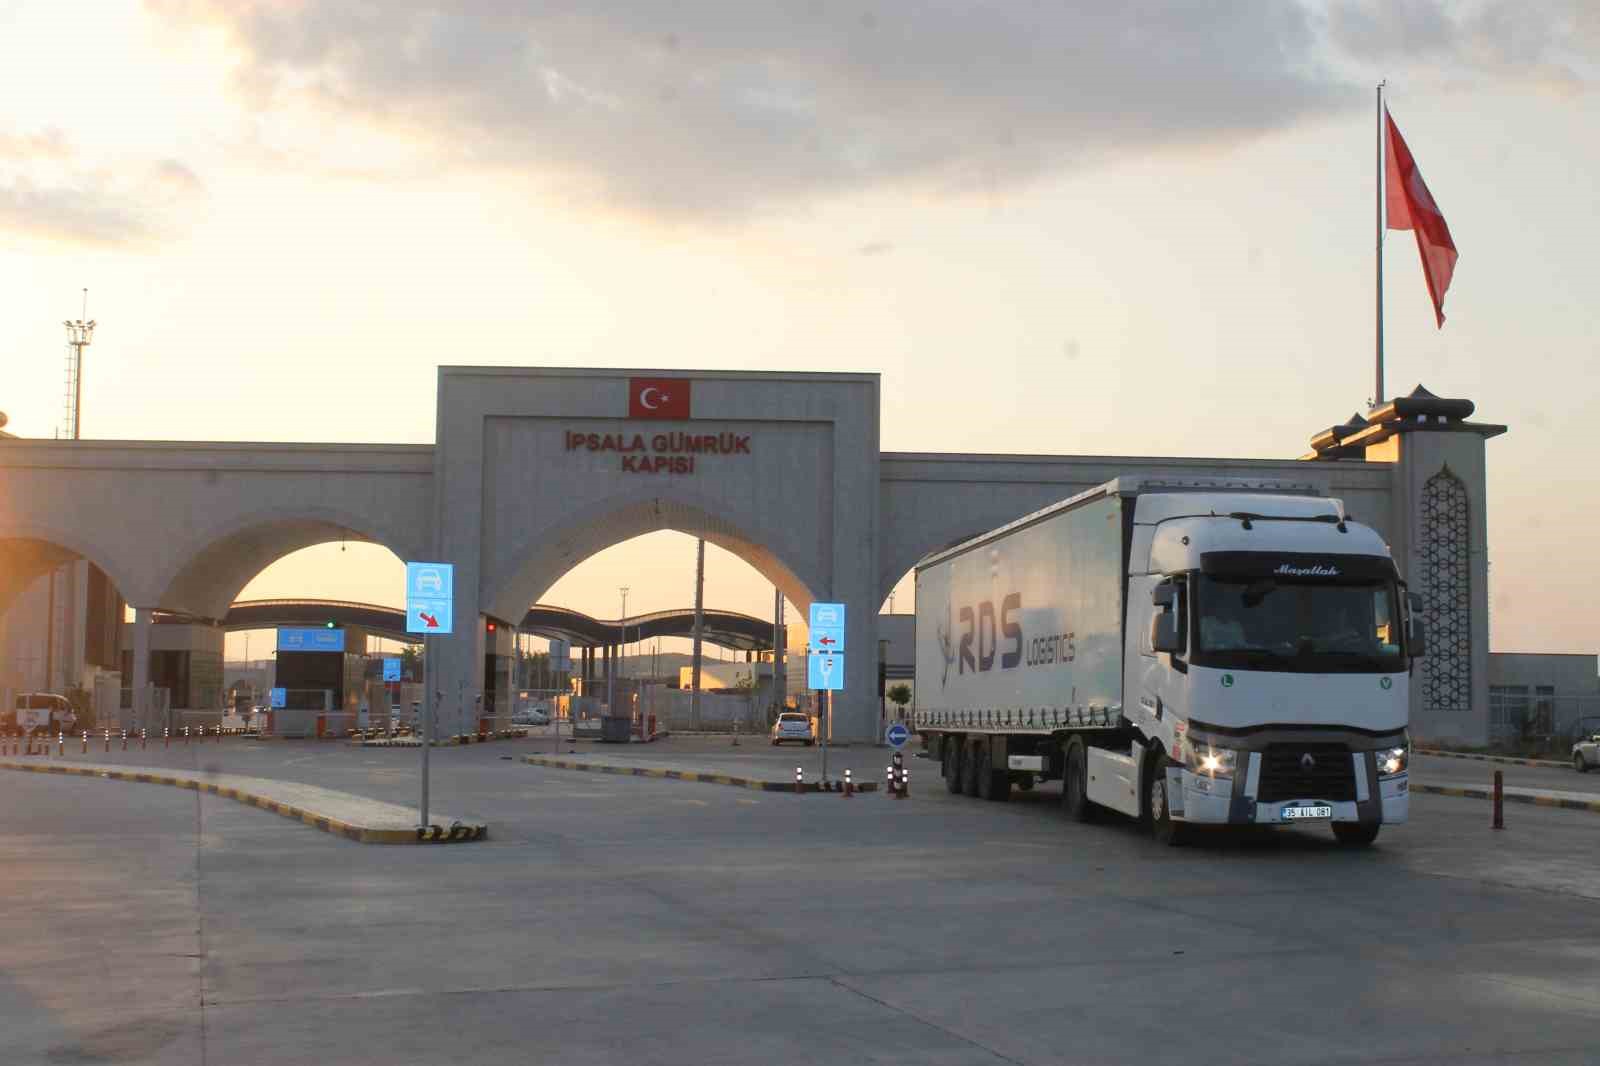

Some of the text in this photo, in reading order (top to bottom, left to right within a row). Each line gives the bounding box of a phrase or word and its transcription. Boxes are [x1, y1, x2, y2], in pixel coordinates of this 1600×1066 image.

[652, 431, 750, 454] GÜMRÜK
[959, 592, 1023, 675] RDS
[1027, 632, 1075, 666] LOGISTICS
